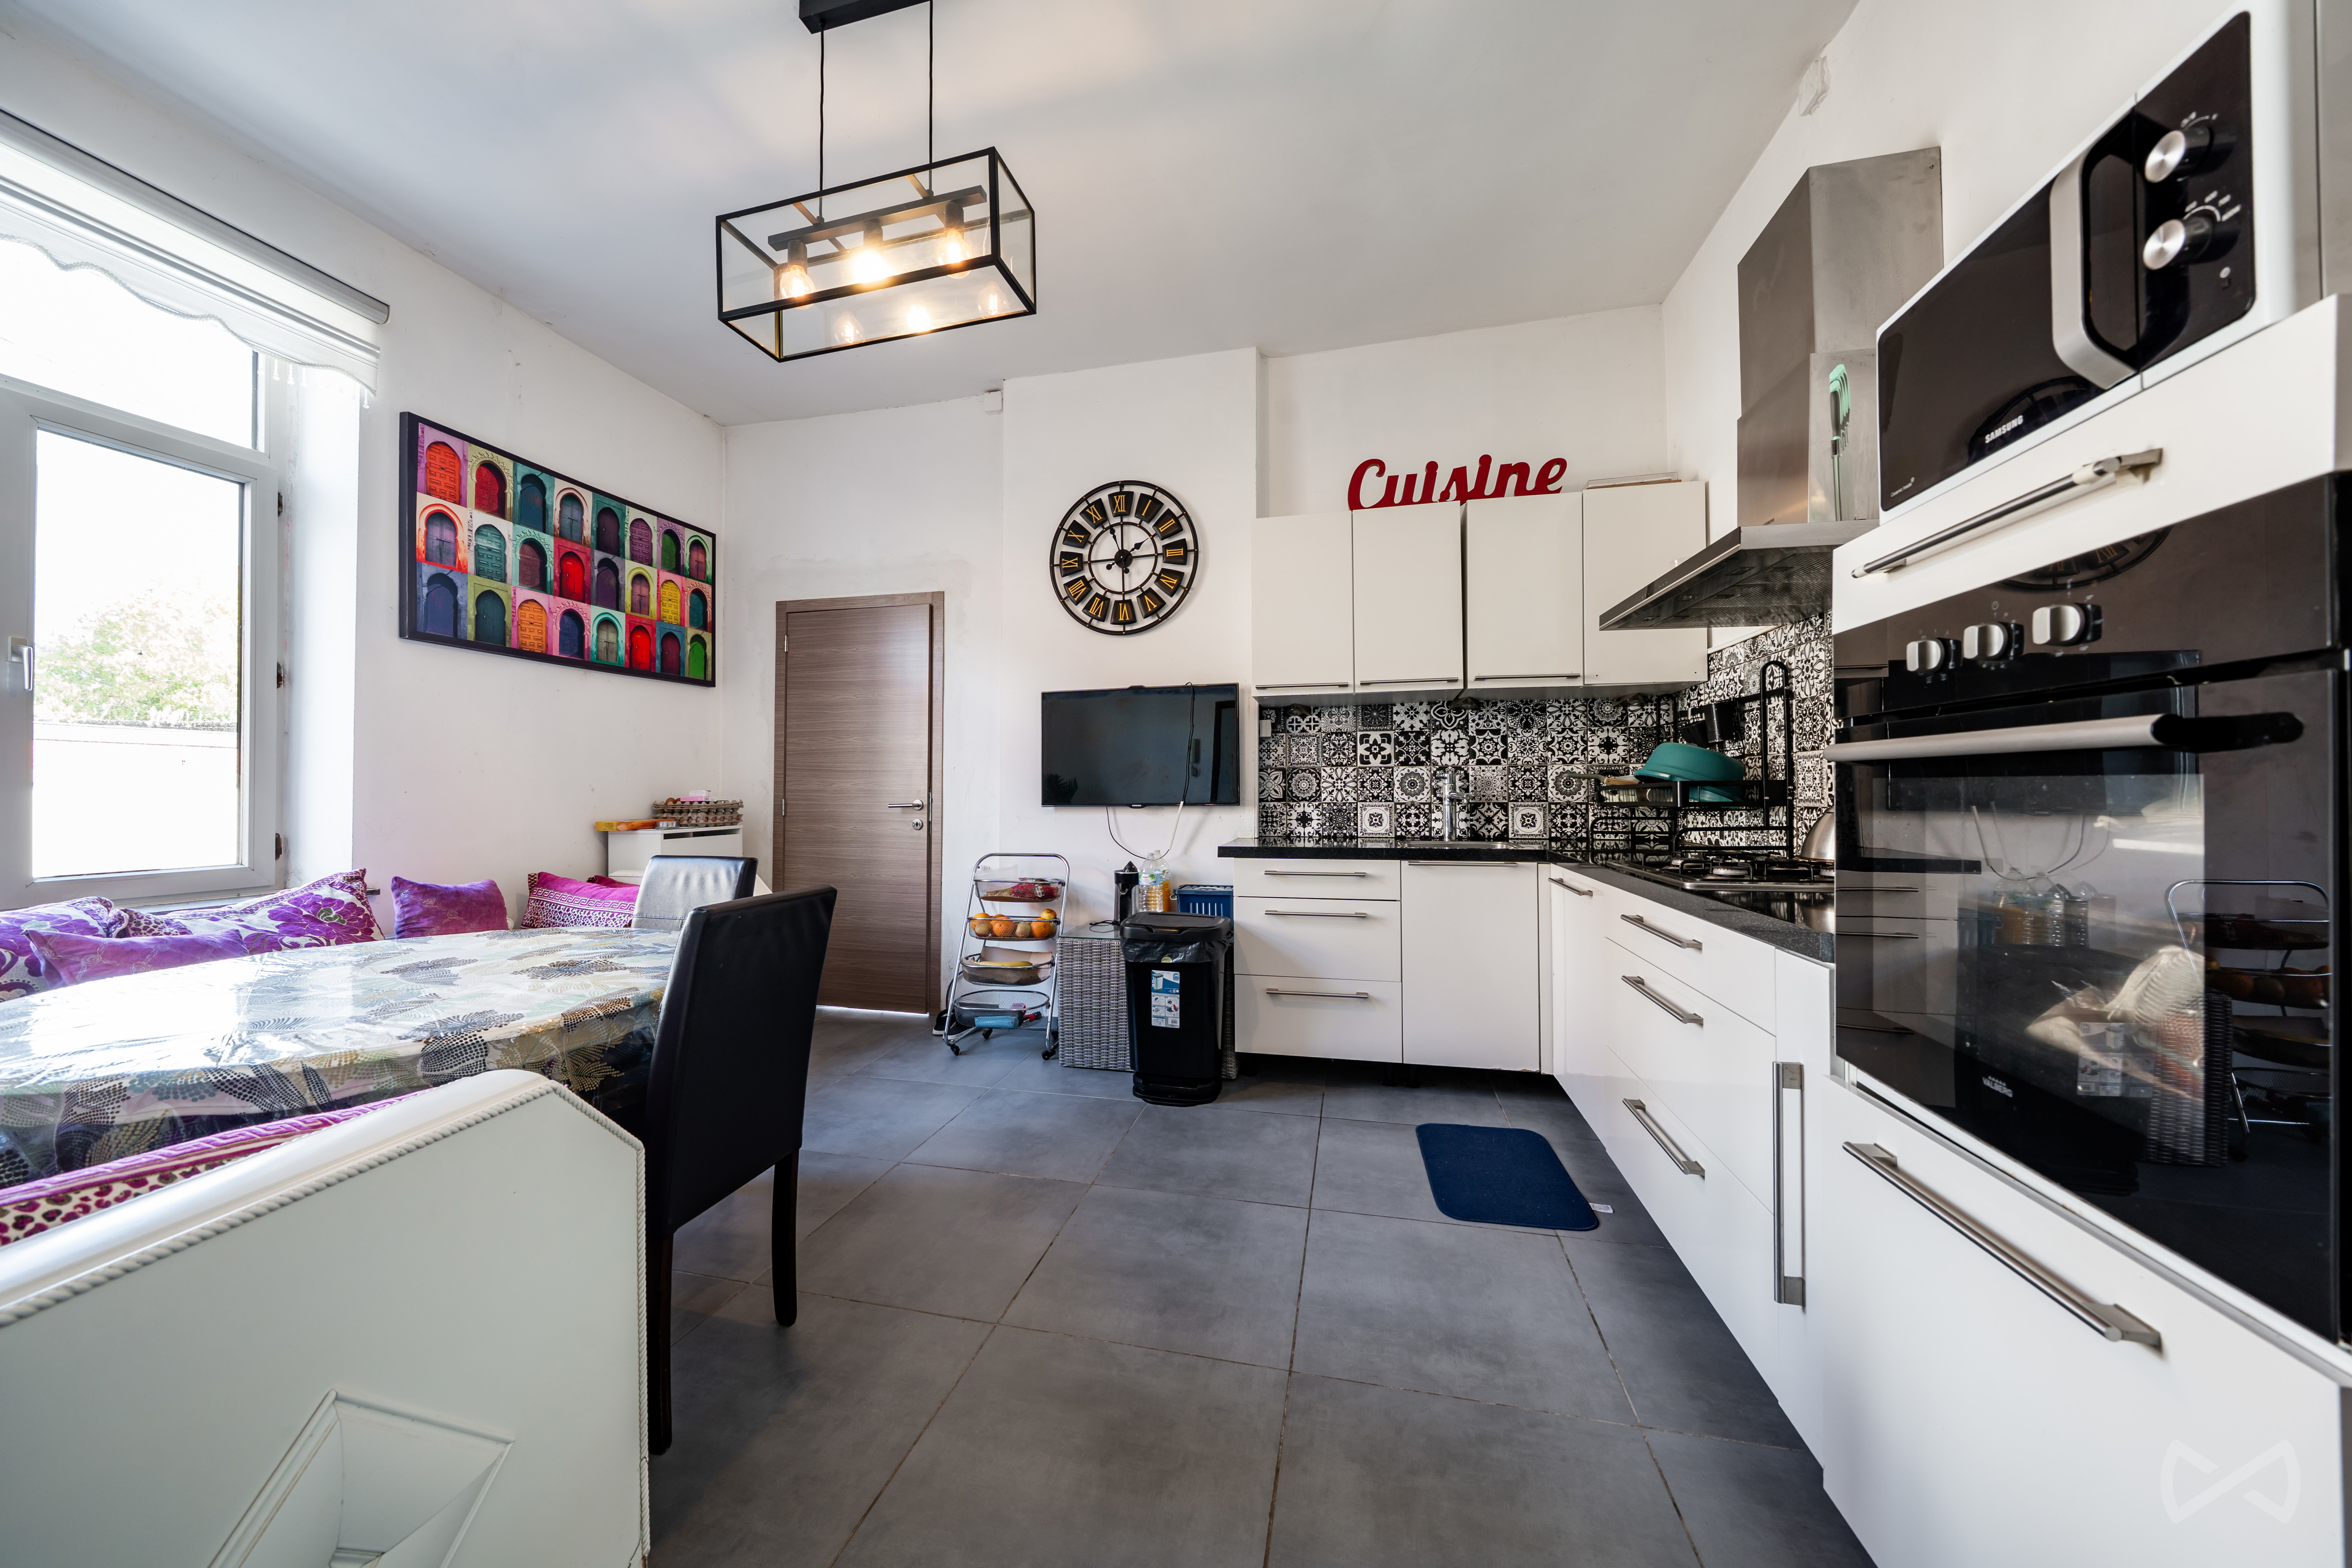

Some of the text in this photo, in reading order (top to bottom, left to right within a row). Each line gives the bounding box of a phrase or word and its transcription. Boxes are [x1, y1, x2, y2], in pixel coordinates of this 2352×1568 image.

[1985, 415, 2023, 443] SAMSUNG
[1348, 454, 1567, 511] Cuisine
[1114, 495, 1125, 513] XII
[1086, 505, 1102, 523] XI
[1159, 519, 1175, 532] II
[1068, 530, 1084, 543] X
[1166, 548, 1183, 557] III
[1062, 557, 1078, 568] IX
[1068, 580, 1086, 600] VIII
[1089, 597, 1103, 617] VII
[1119, 603, 1129, 620] VI
[1145, 595, 1157, 611] V
[1982, 1077, 2013, 1097] VALBERG
